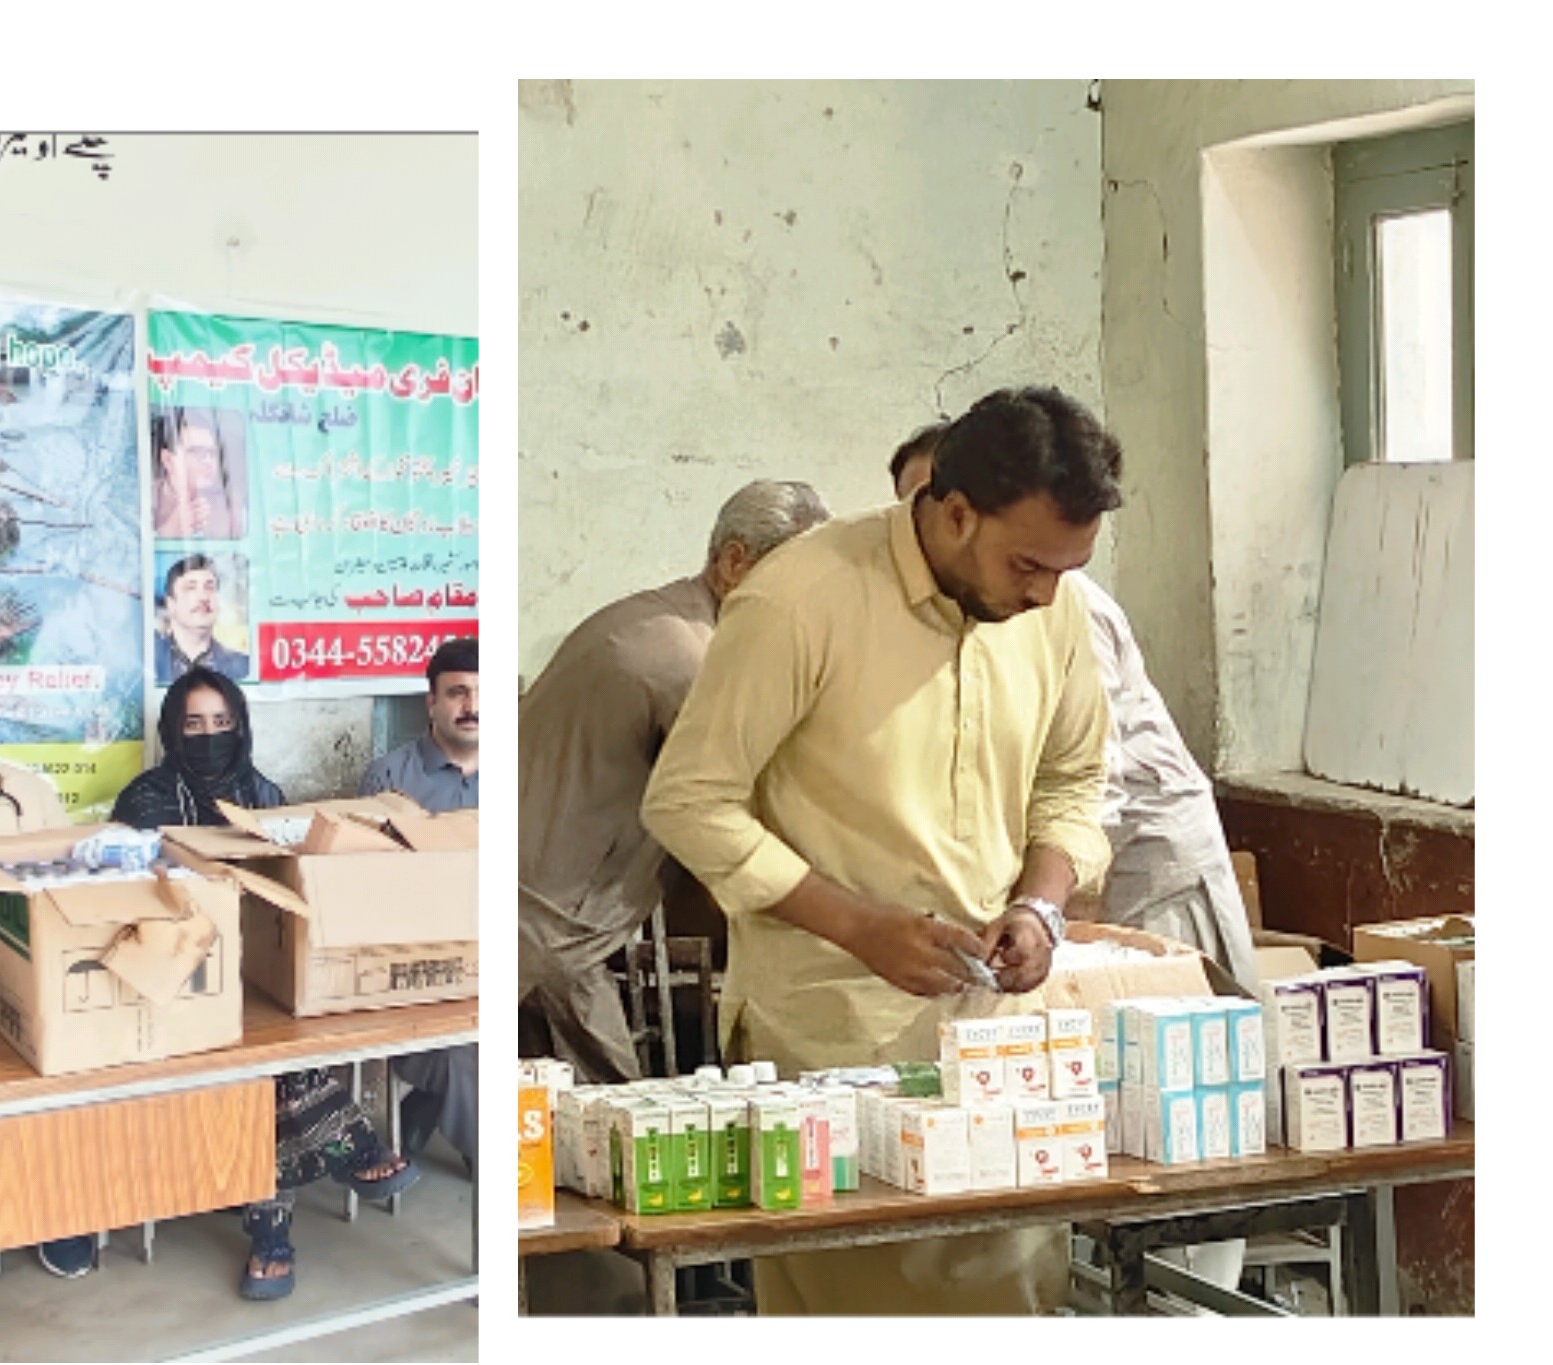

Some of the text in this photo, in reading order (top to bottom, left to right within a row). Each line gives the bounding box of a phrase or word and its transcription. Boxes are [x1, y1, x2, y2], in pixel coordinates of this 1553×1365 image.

[148, 344, 254, 392] کیمپ
[257, 342, 386, 394] میڈیکل
[389, 356, 451, 399] فری
[344, 584, 425, 615] صاحب
[272, 635, 438, 669] 0344-55824
